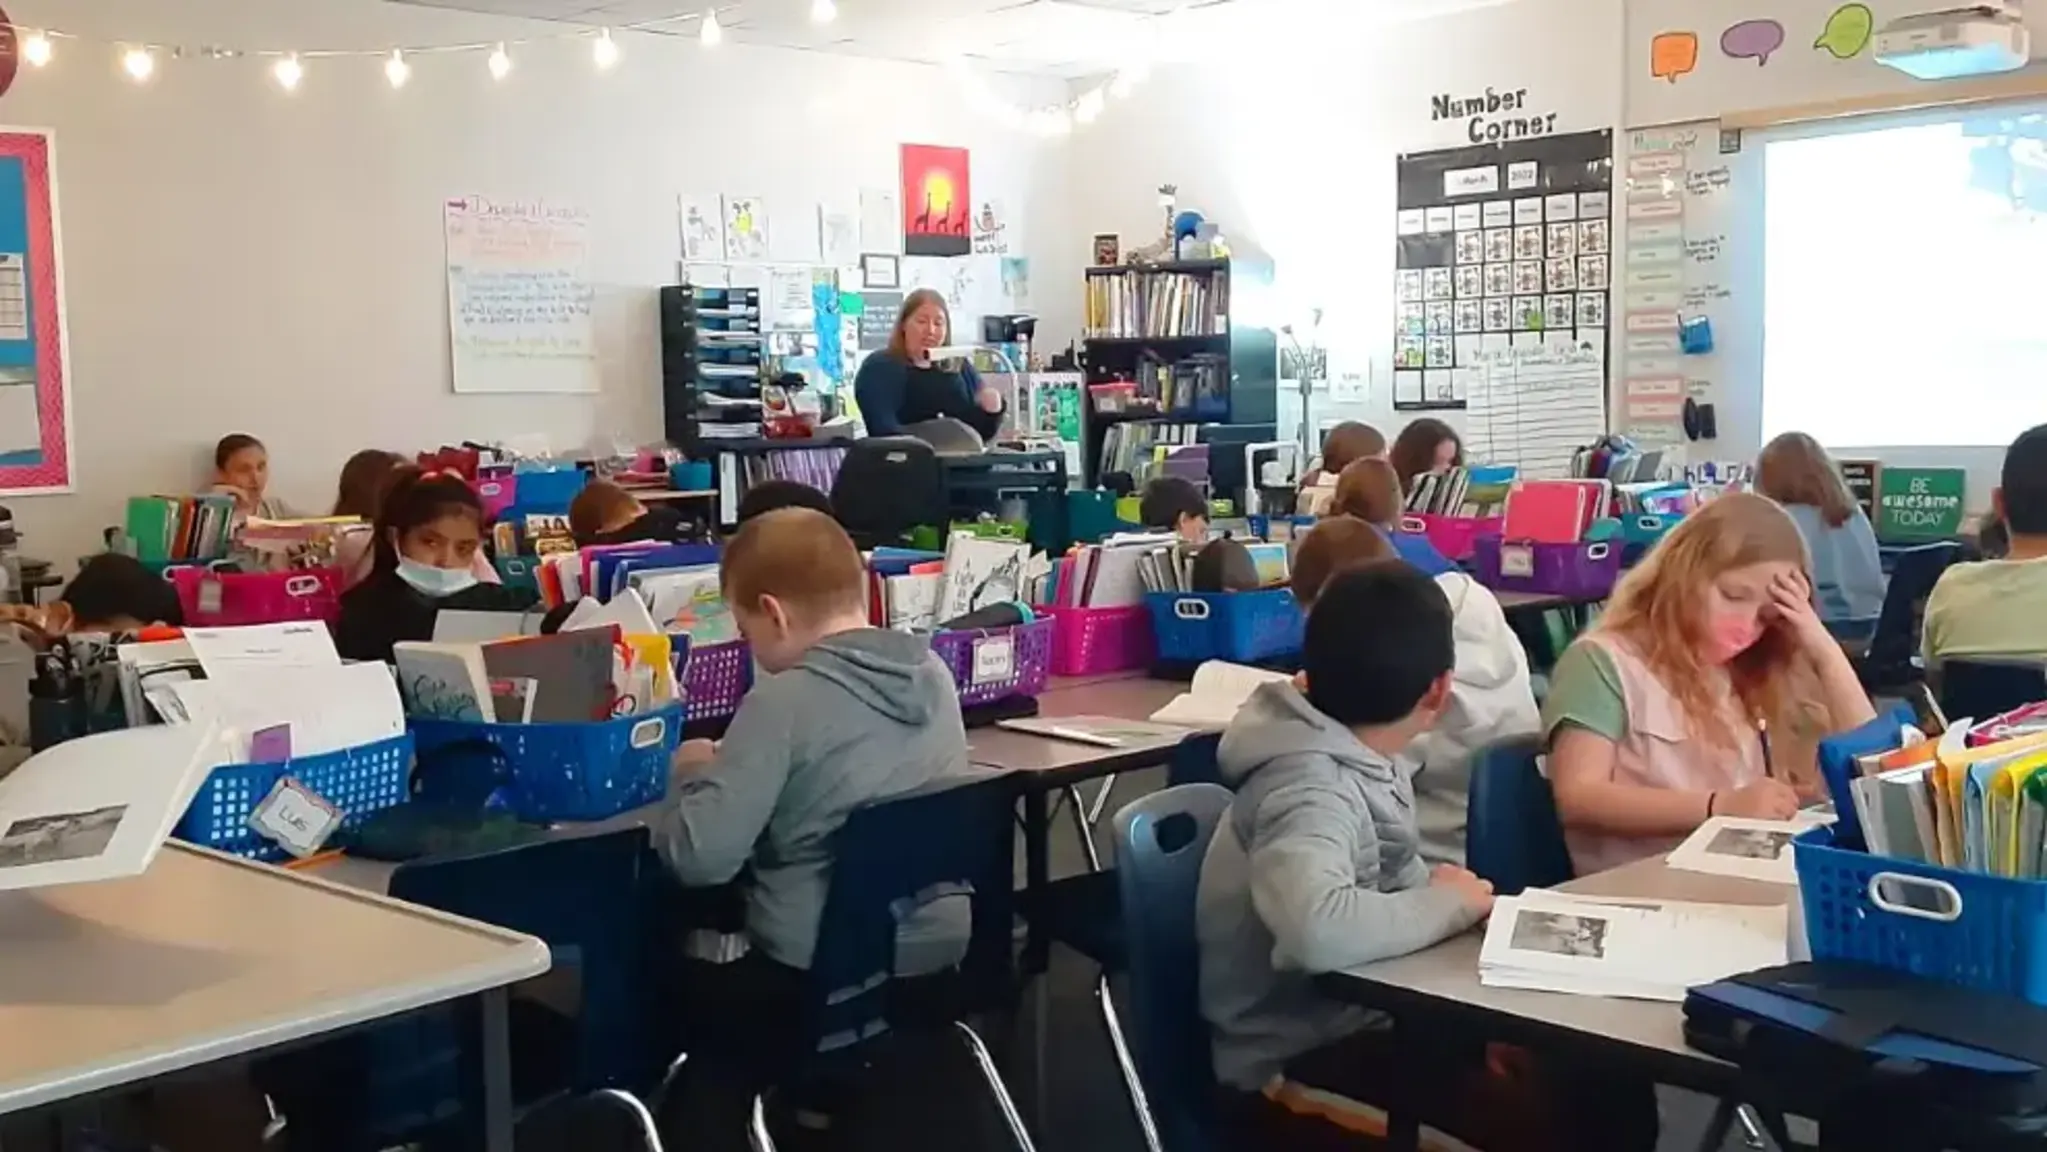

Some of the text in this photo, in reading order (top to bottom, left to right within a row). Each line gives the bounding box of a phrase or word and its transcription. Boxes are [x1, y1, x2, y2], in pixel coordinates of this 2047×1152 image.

[1432, 87, 1527, 120] Number
[1468, 112, 1557, 143] Corner
[1909, 477, 1932, 494] BE
[1882, 495, 1959, 508] awesome
[1893, 509, 1946, 526] TODAY
